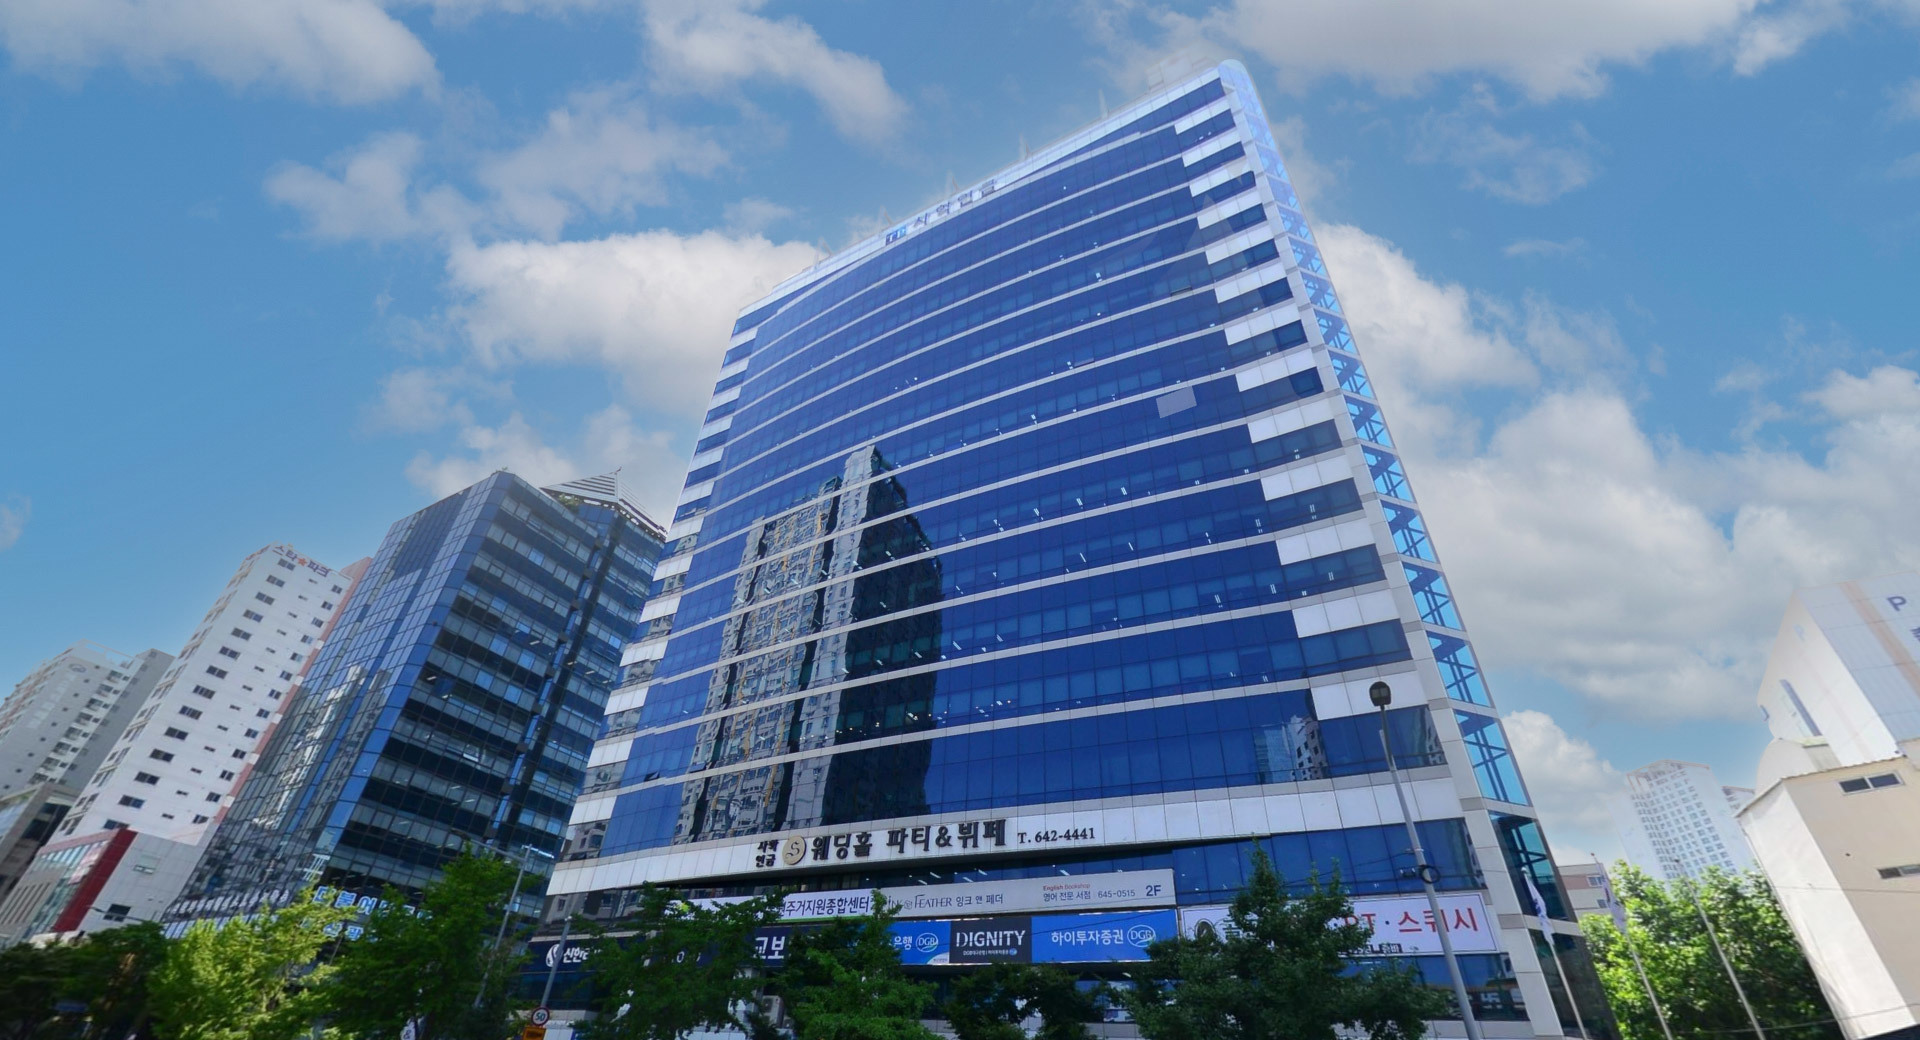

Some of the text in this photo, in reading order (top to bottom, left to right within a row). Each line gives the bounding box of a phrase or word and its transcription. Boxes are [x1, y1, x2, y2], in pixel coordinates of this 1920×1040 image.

[757, 839, 779, 853] 사학
[811, 832, 872, 861] 웨딩홀
[886, 819, 1007, 854] 파티&뷔페
[1035, 827, 1095, 843] 642-4441
[755, 853, 777, 868] 연금
[1043, 882, 1091, 892] English Bookshop
[1043, 885, 1161, 902] 영어 전문 서점 645-0515 2F
[914, 894, 952, 909] FEATHER
[956, 893, 1003, 907] 잉크 앤 페더
[956, 930, 1026, 948] DIGNITY
[1051, 929, 1124, 946] 하이투자증권
[535, 1011, 546, 1022] 50
